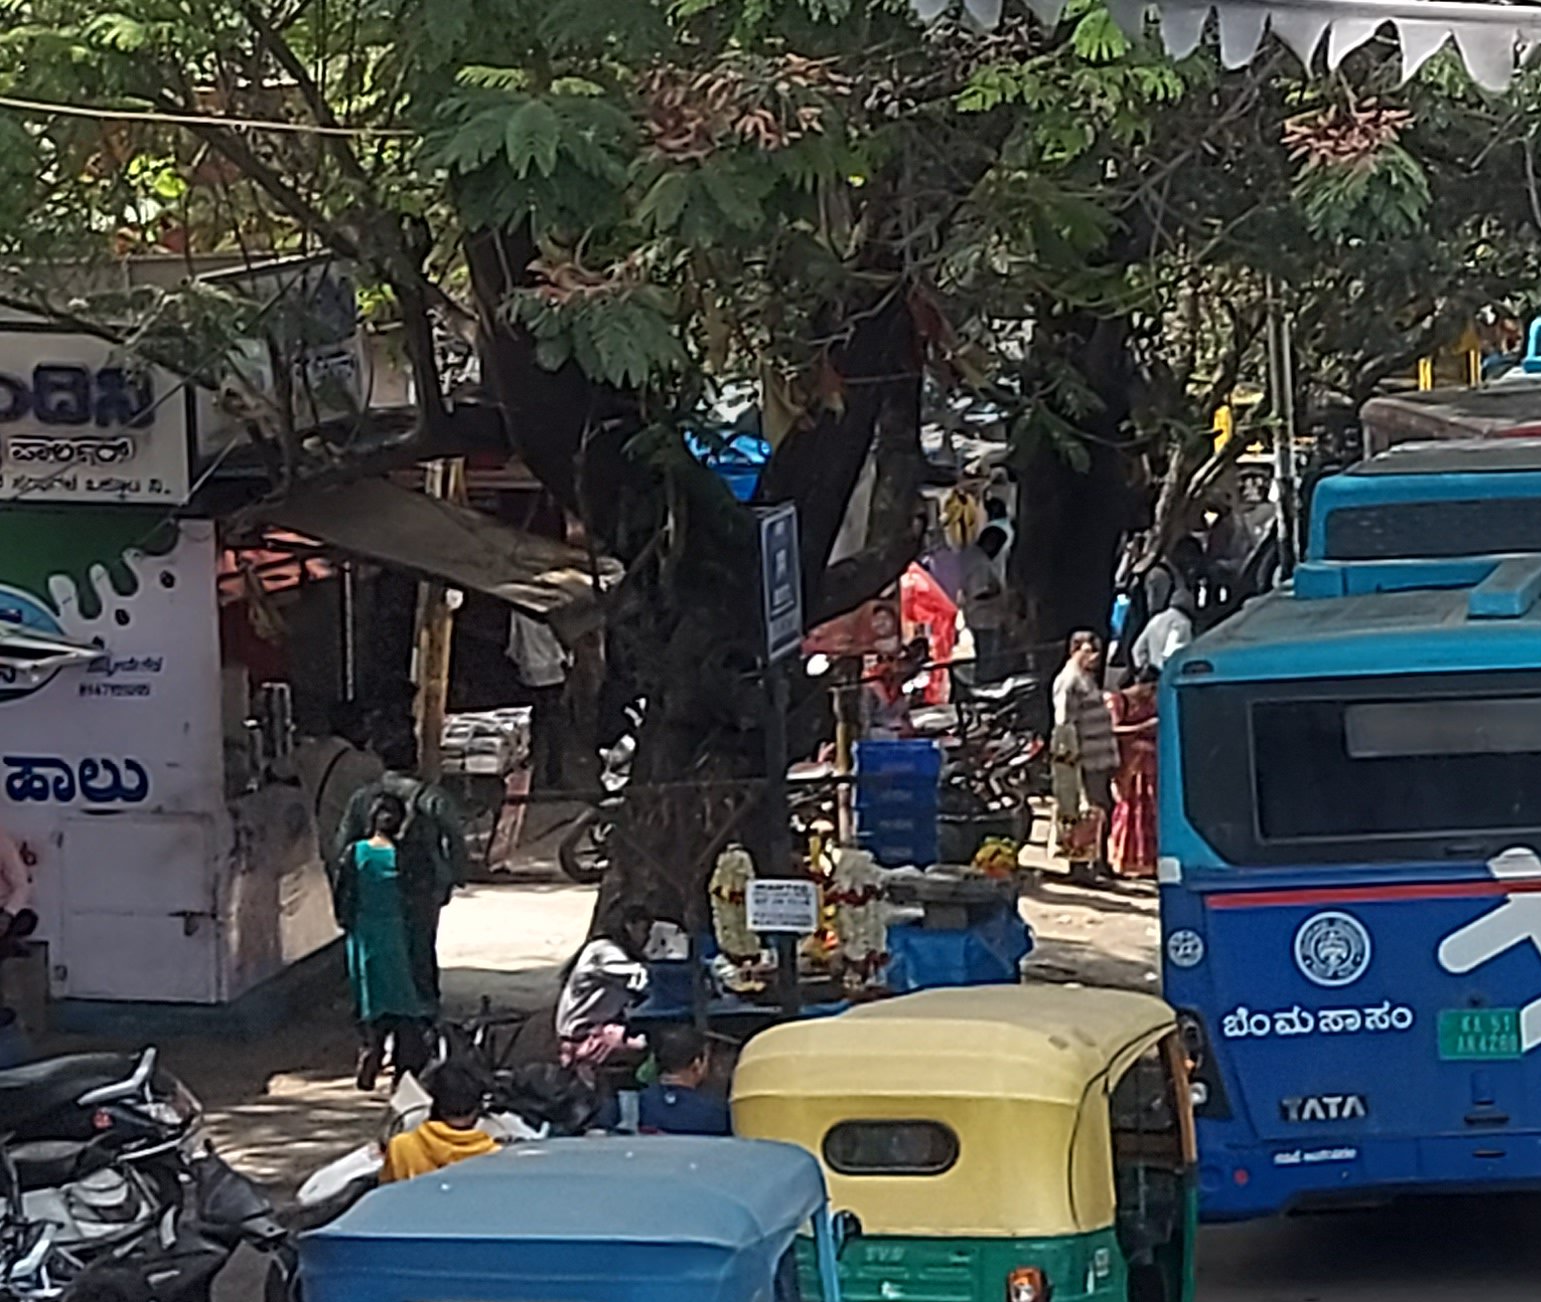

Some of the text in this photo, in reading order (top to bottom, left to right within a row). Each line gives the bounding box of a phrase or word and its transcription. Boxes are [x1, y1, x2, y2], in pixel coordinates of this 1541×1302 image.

[3, 756, 150, 802] ಹಾಲು
[1222, 999, 1414, 1039] ಬೆಂಮಸಾಸಂ
[1281, 1095, 1366, 1121] TATA
